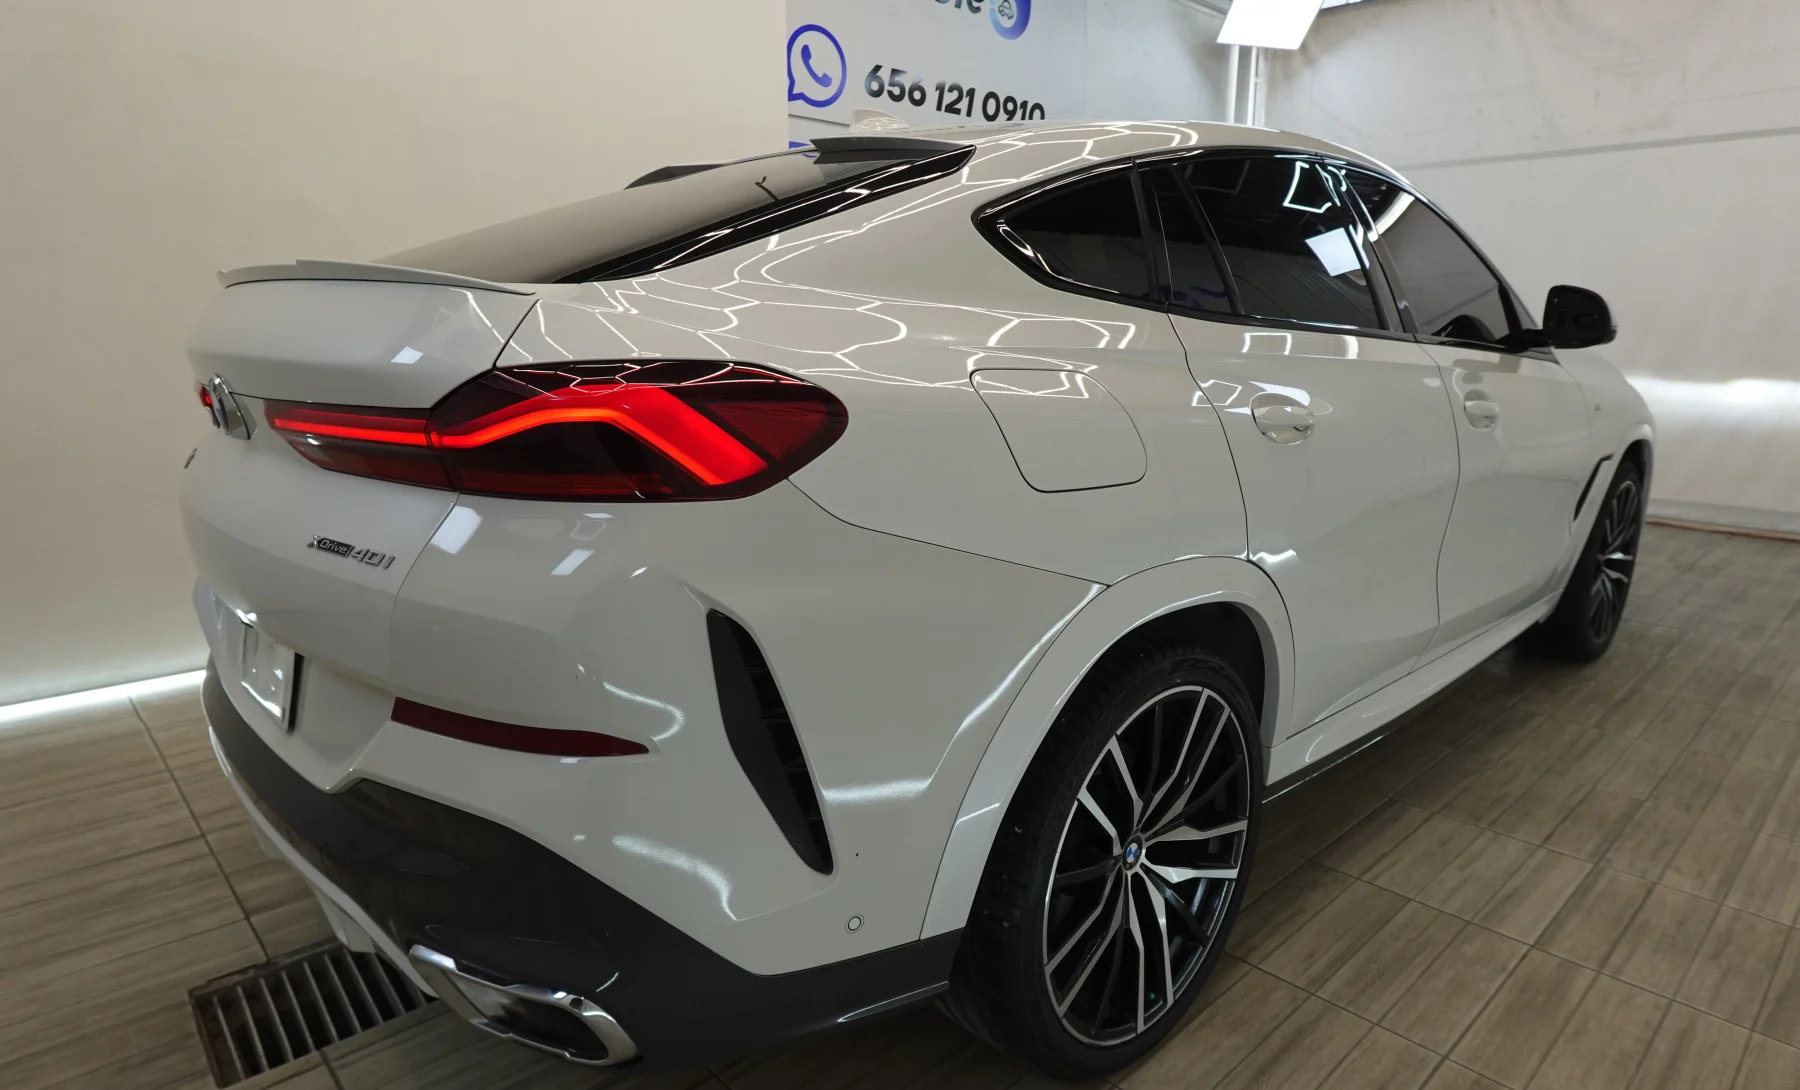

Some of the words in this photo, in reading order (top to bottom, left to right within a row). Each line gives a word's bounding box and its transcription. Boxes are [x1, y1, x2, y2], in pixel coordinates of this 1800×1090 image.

[864, 64, 927, 107] 656
[935, 80, 976, 118] 121
[982, 91, 1045, 122] 0910
